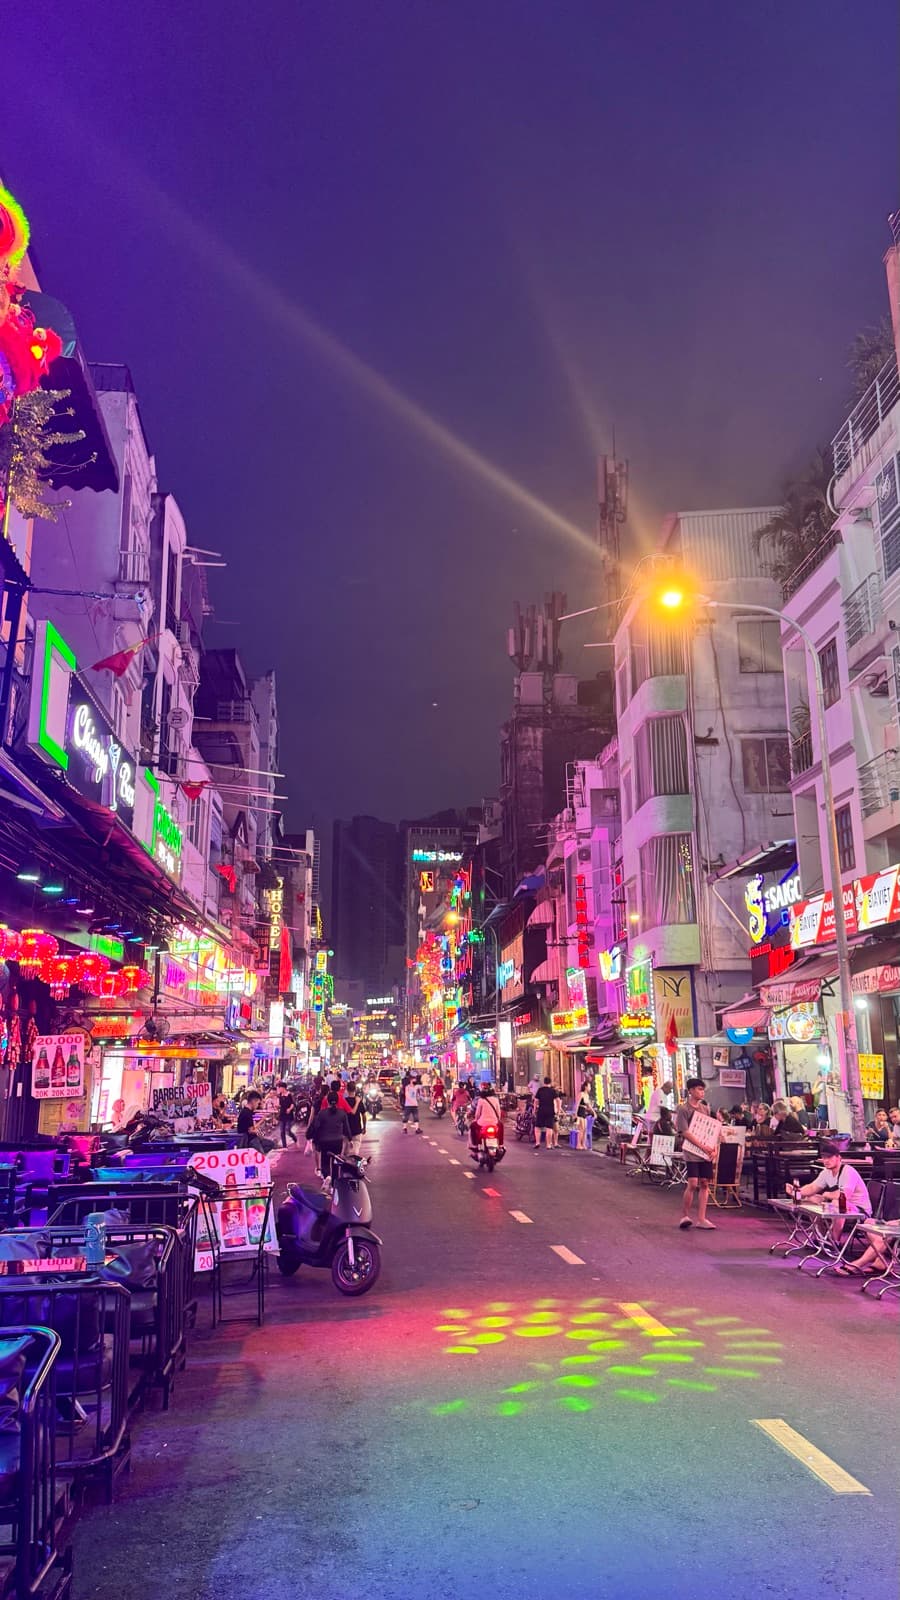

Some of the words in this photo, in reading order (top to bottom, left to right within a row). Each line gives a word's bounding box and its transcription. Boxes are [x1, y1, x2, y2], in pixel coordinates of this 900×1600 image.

[269, 889, 283, 950] HOTEL
[657, 975, 687, 997] NY
[36, 1035, 82, 1046] 20.000
[35, 1089, 49, 1098] 20K
[51, 1089, 65, 1097] 20K
[66, 1087, 80, 1096] 20K
[153, 1086, 185, 1101] BARBER
[186, 1083, 210, 1099] SHOP
